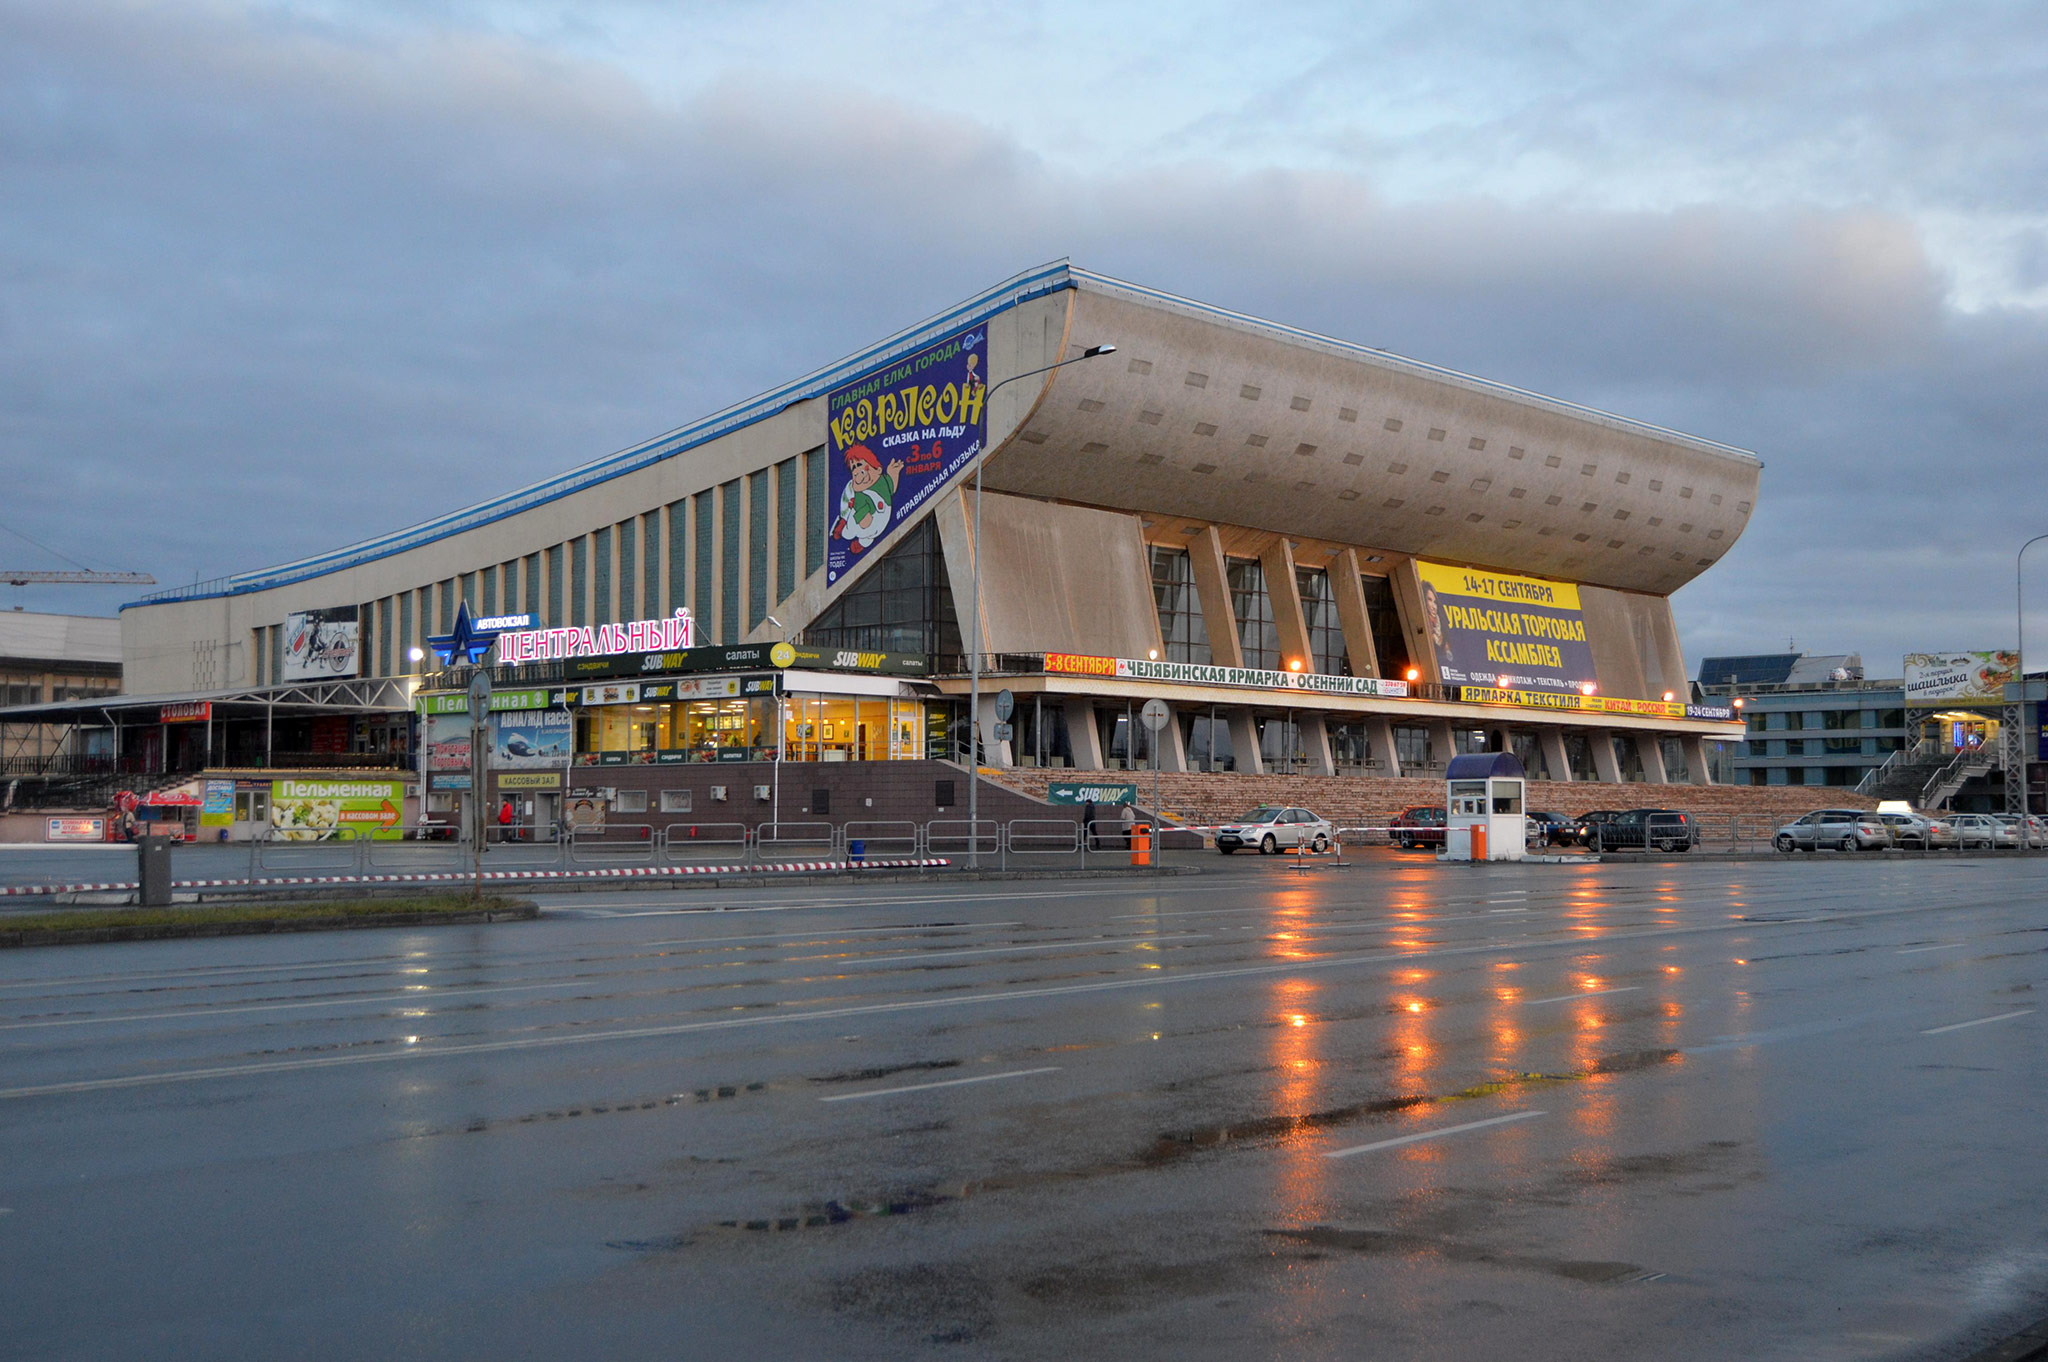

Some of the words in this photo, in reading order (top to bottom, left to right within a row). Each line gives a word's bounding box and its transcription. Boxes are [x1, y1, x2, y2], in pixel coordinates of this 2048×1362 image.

[831, 376, 881, 411] ГЛАВНАЯ
[883, 363, 912, 387] ЕЛКА
[915, 340, 961, 374] ГОРОДА
[882, 430, 919, 448] СКАЗКА
[922, 429, 936, 440] НА
[938, 424, 966, 439] ЛЬДУ
[911, 444, 921, 463] 3
[921, 451, 932, 461] по
[932, 440, 943, 459] 6
[905, 461, 942, 476] ЯНВАРЯ
[896, 466, 949, 521] #ПРАВИЛЬНАЯ
[948, 439, 980, 473] МУЗЫКА
[1463, 575, 1494, 595] 14-17
[1498, 580, 1554, 603] СЕНТЯБРЯ
[476, 614, 530, 630] АВТОВОКЗАЛ
[1443, 604, 1522, 636] УРАЛЬСКАЯ
[1521, 614, 1586, 642] ТОРГОВАЯ
[499, 608, 692, 666] ЦЕНТРАЛЬНЫЙ
[642, 652, 688, 670] SUBWAY
[725, 649, 760, 661] салаты
[776, 649, 790, 660] 24
[833, 650, 887, 668] SUBWAY
[1486, 639, 1563, 668] АССАМБЛЕЯ
[902, 659, 923, 667] салаты
[1045, 653, 1063, 671] 5-8
[1064, 655, 1115, 675] СЕНТЯБРЯ
[1127, 660, 1226, 682] ЧЕЛЯБИНСКАЯ
[1228, 670, 1289, 687] ЯРМАРКА
[1297, 674, 1353, 692] ОСЕННИЙ
[1356, 678, 1378, 695] САД
[1470, 671, 1496, 682] ОДЕЖДА
[1537, 677, 1564, 687] ТЕКСТИЛЬ
[1907, 673, 1968, 692] шашлыка
[644, 685, 673, 698] SUBWAY
[745, 680, 774, 692] SUBWAY
[437, 694, 528, 711] Пелнная
[1465, 687, 1522, 704] ЯРМАРКА
[1525, 692, 1580, 708] ТЕКСТИЛЯ
[1605, 699, 1632, 712] КИТАЙ
[1637, 702, 1666, 713] РОССИЯ
[161, 703, 206, 718] СТОЛОВАЯ
[501, 710, 543, 728] АВИА/ЖД
[1687, 705, 1701, 716] 19-24
[1702, 707, 1730, 718] СЕНТЯБРЯ
[435, 743, 471, 754] Приглашае
[282, 780, 393, 797] Пельменная
[504, 777, 541, 786] КАССОВЫЙ
[541, 776, 555, 785] ЗАЛ
[1075, 787, 1129, 802] SUBWAY
[347, 812, 379, 820] кассовом
[380, 812, 396, 820] зале
